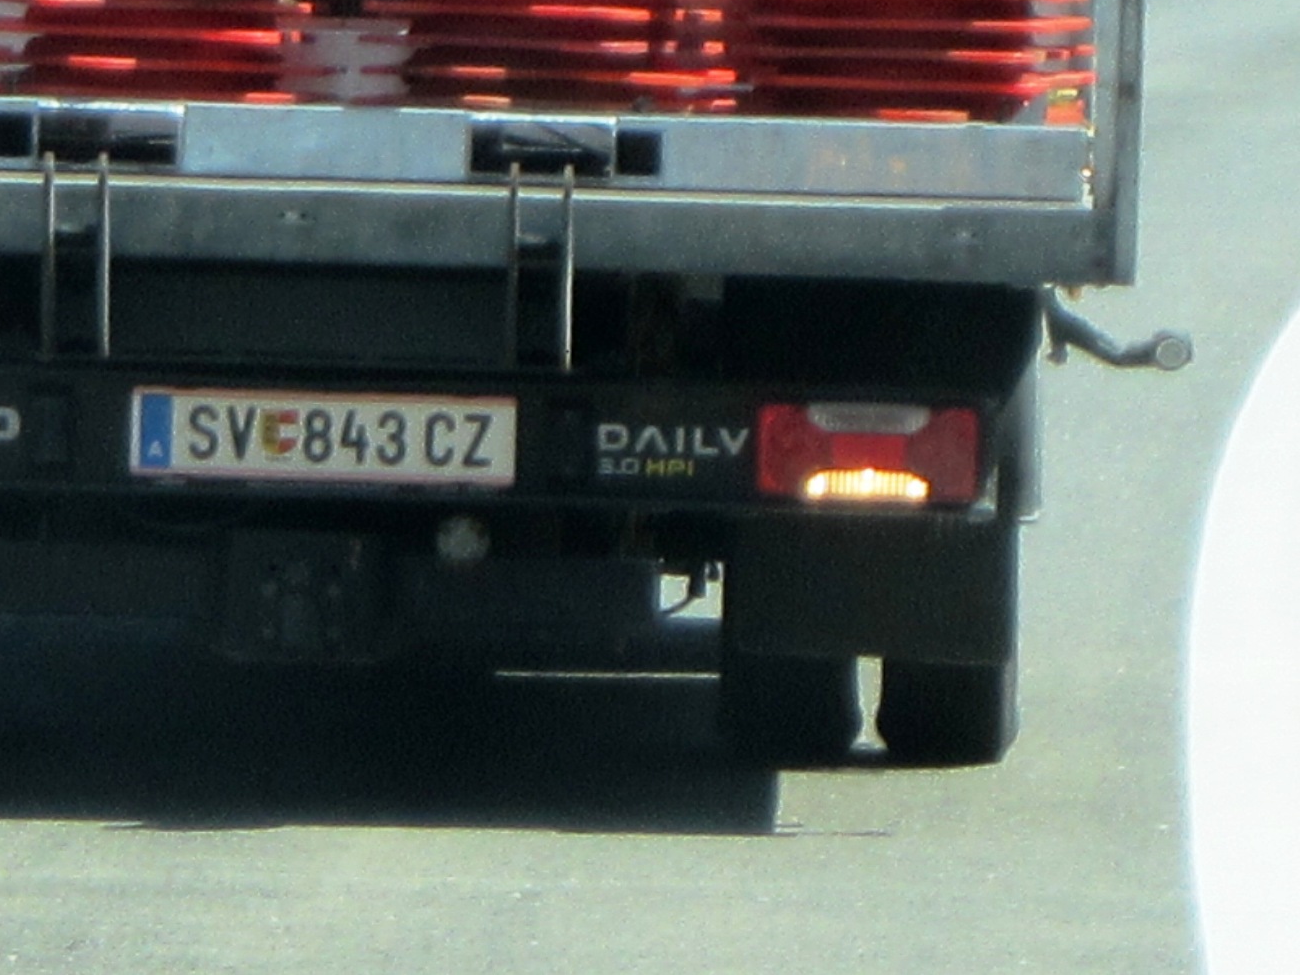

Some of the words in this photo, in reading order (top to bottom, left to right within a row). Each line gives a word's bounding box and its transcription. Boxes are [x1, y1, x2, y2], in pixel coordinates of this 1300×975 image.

[188, 403, 259, 461] SV
[302, 408, 406, 466] 843
[424, 412, 494, 468] CZ
[147, 440, 163, 458] A
[646, 458, 695, 477] HPI
